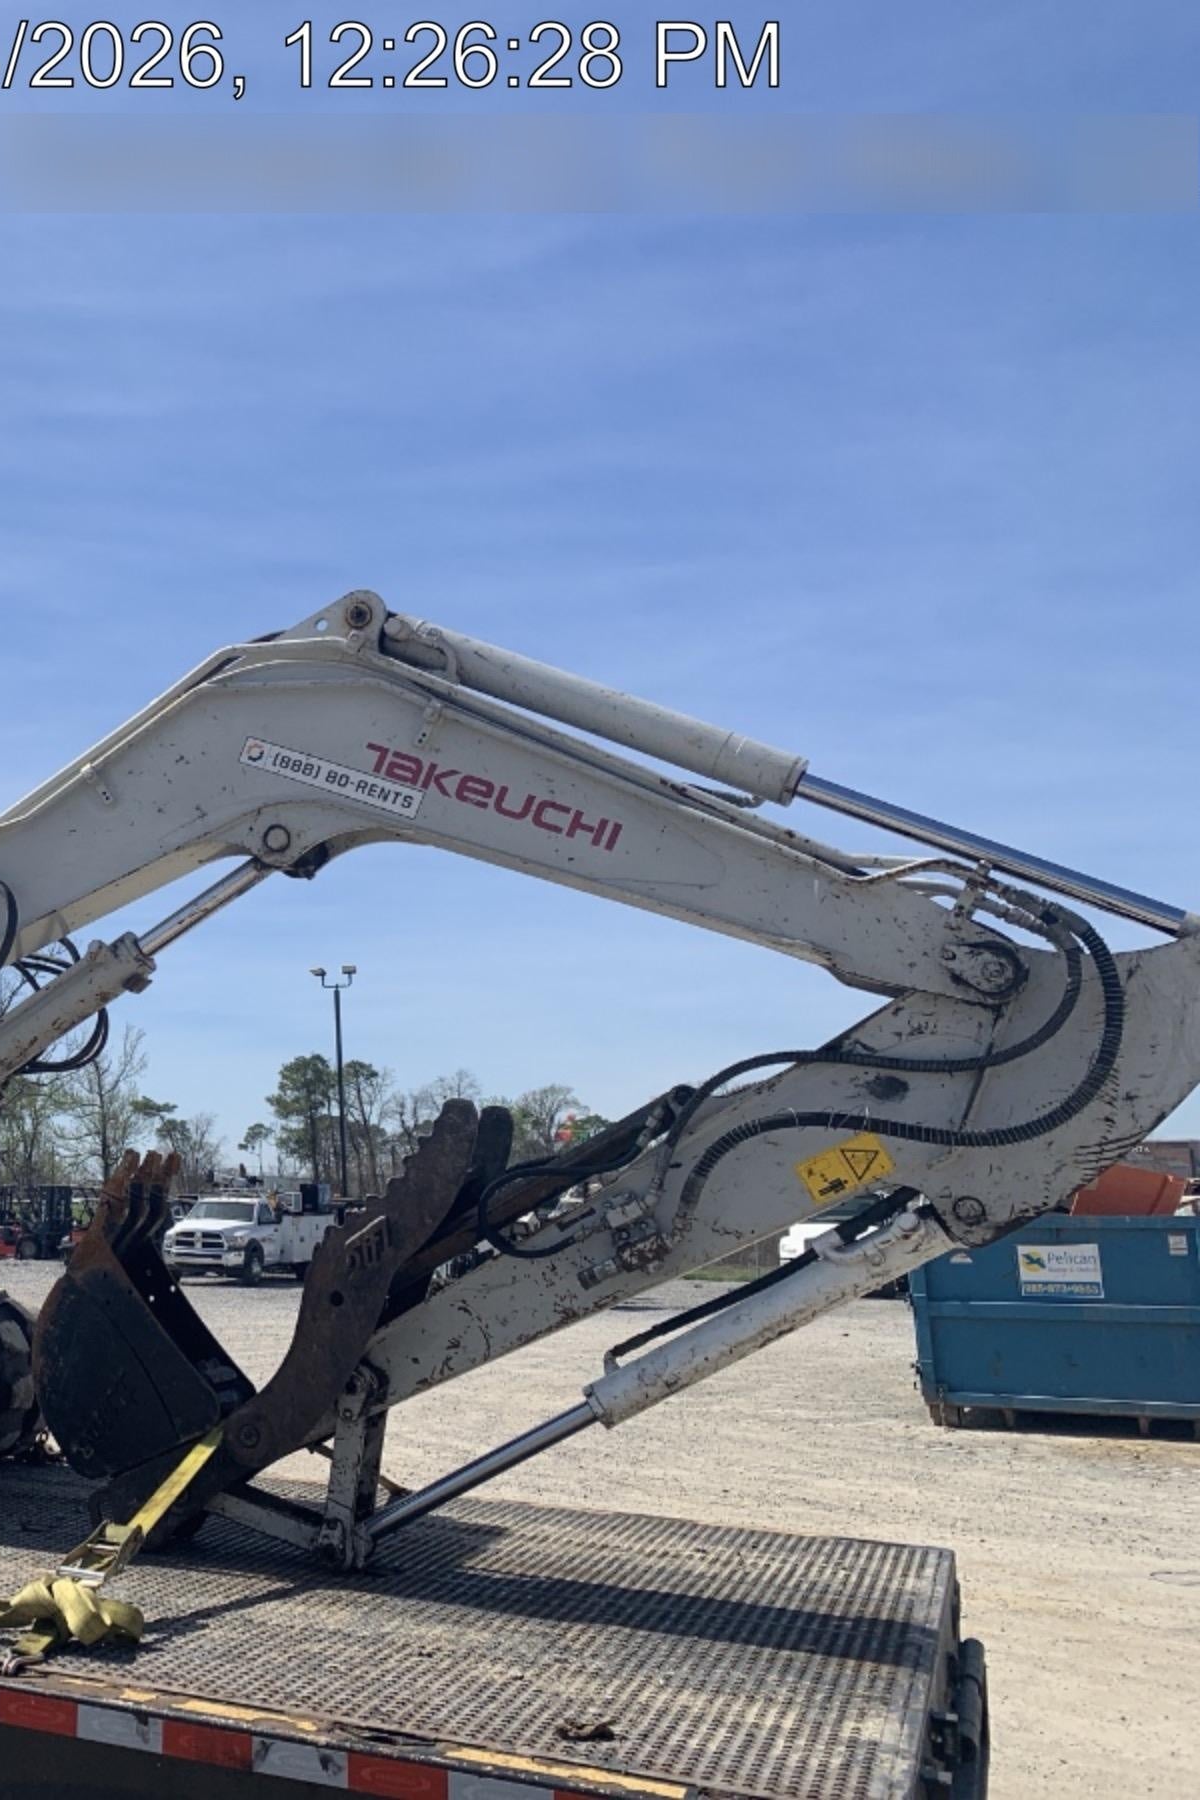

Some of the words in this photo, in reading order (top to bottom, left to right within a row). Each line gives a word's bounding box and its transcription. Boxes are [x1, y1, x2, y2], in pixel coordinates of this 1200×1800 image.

[272, 752, 321, 779] (888)
[325, 773, 414, 809] 80-RENTS
[1047, 1251, 1097, 1265] Pelican
